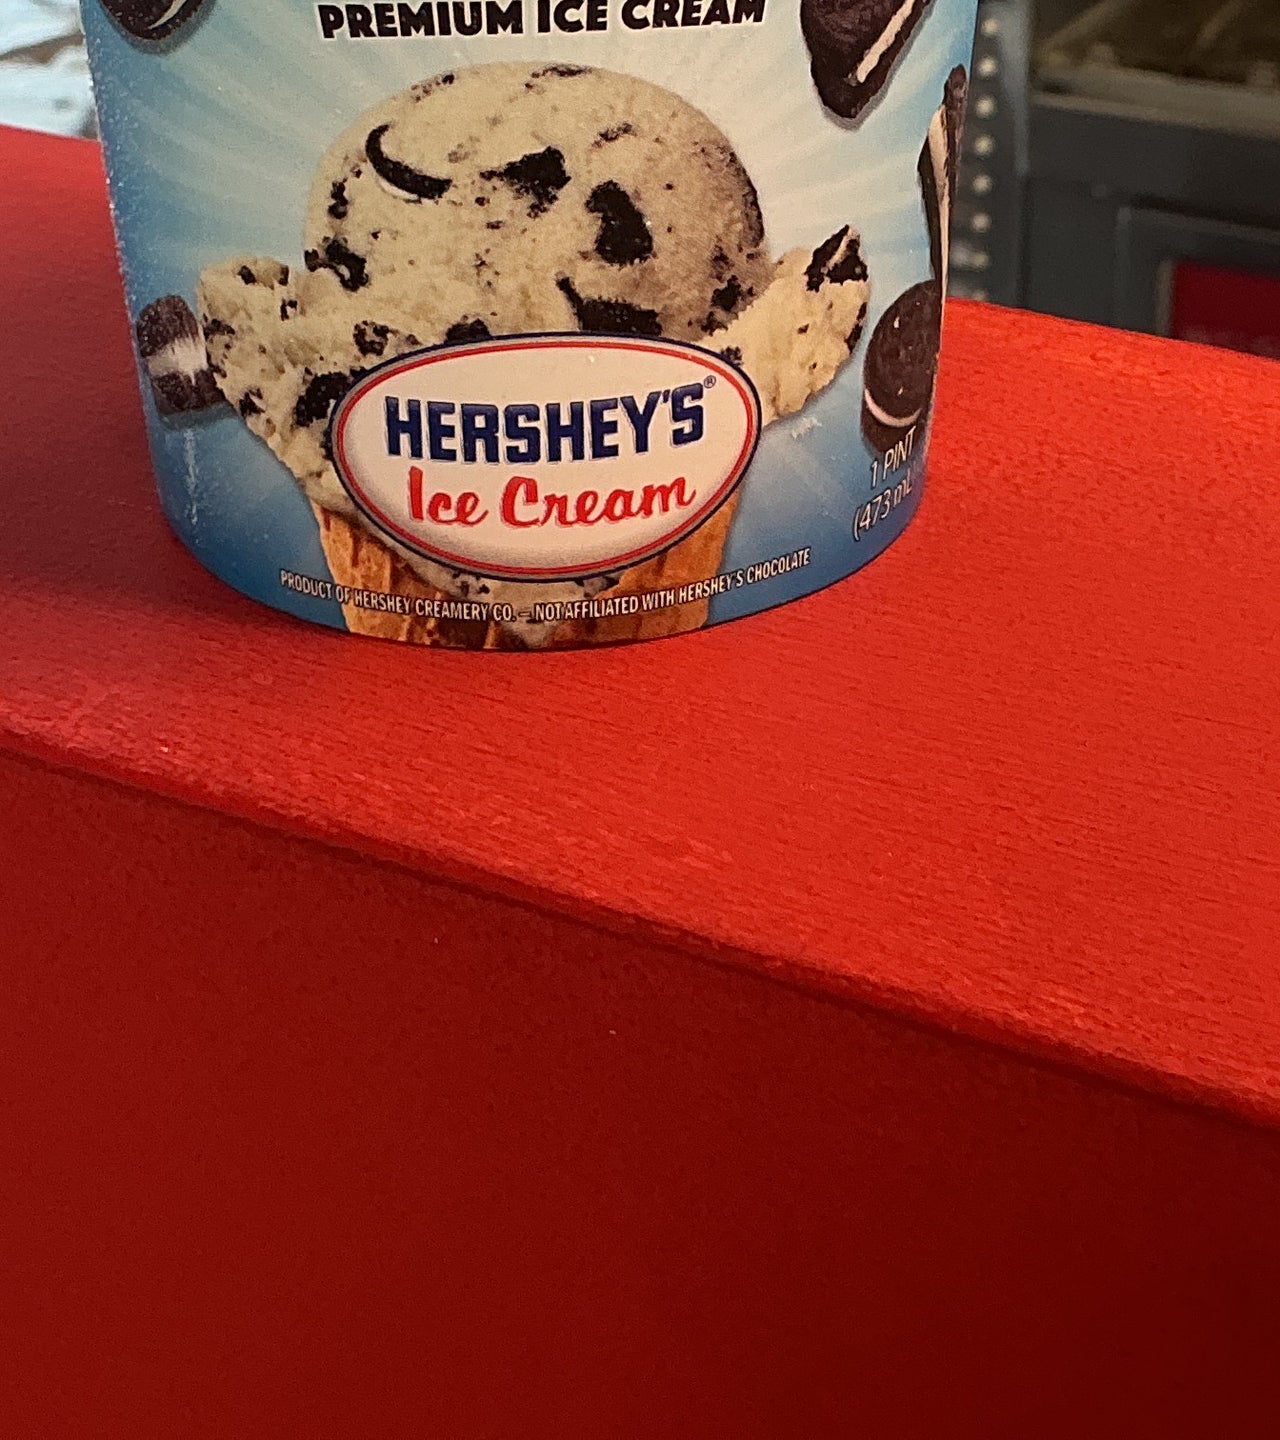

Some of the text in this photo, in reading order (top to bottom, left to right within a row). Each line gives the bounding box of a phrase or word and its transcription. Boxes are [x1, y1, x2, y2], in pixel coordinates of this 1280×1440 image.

[871, 425, 916, 488] 1 PINT
[408, 465, 697, 528] Ice Cream
[280, 569, 333, 600] PRODUCT
[335, 585, 352, 604] OF
[354, 589, 411, 615] HERSHEY
[415, 598, 489, 621] CREAMERY
[493, 603, 517, 622] CO.
[535, 603, 562, 622] NOT
[564, 595, 639, 620] AFFILIATED
[641, 588, 675, 610] WITH
[677, 571, 744, 602] HERSHEY'S
[746, 547, 812, 587] CHOCOLATE
